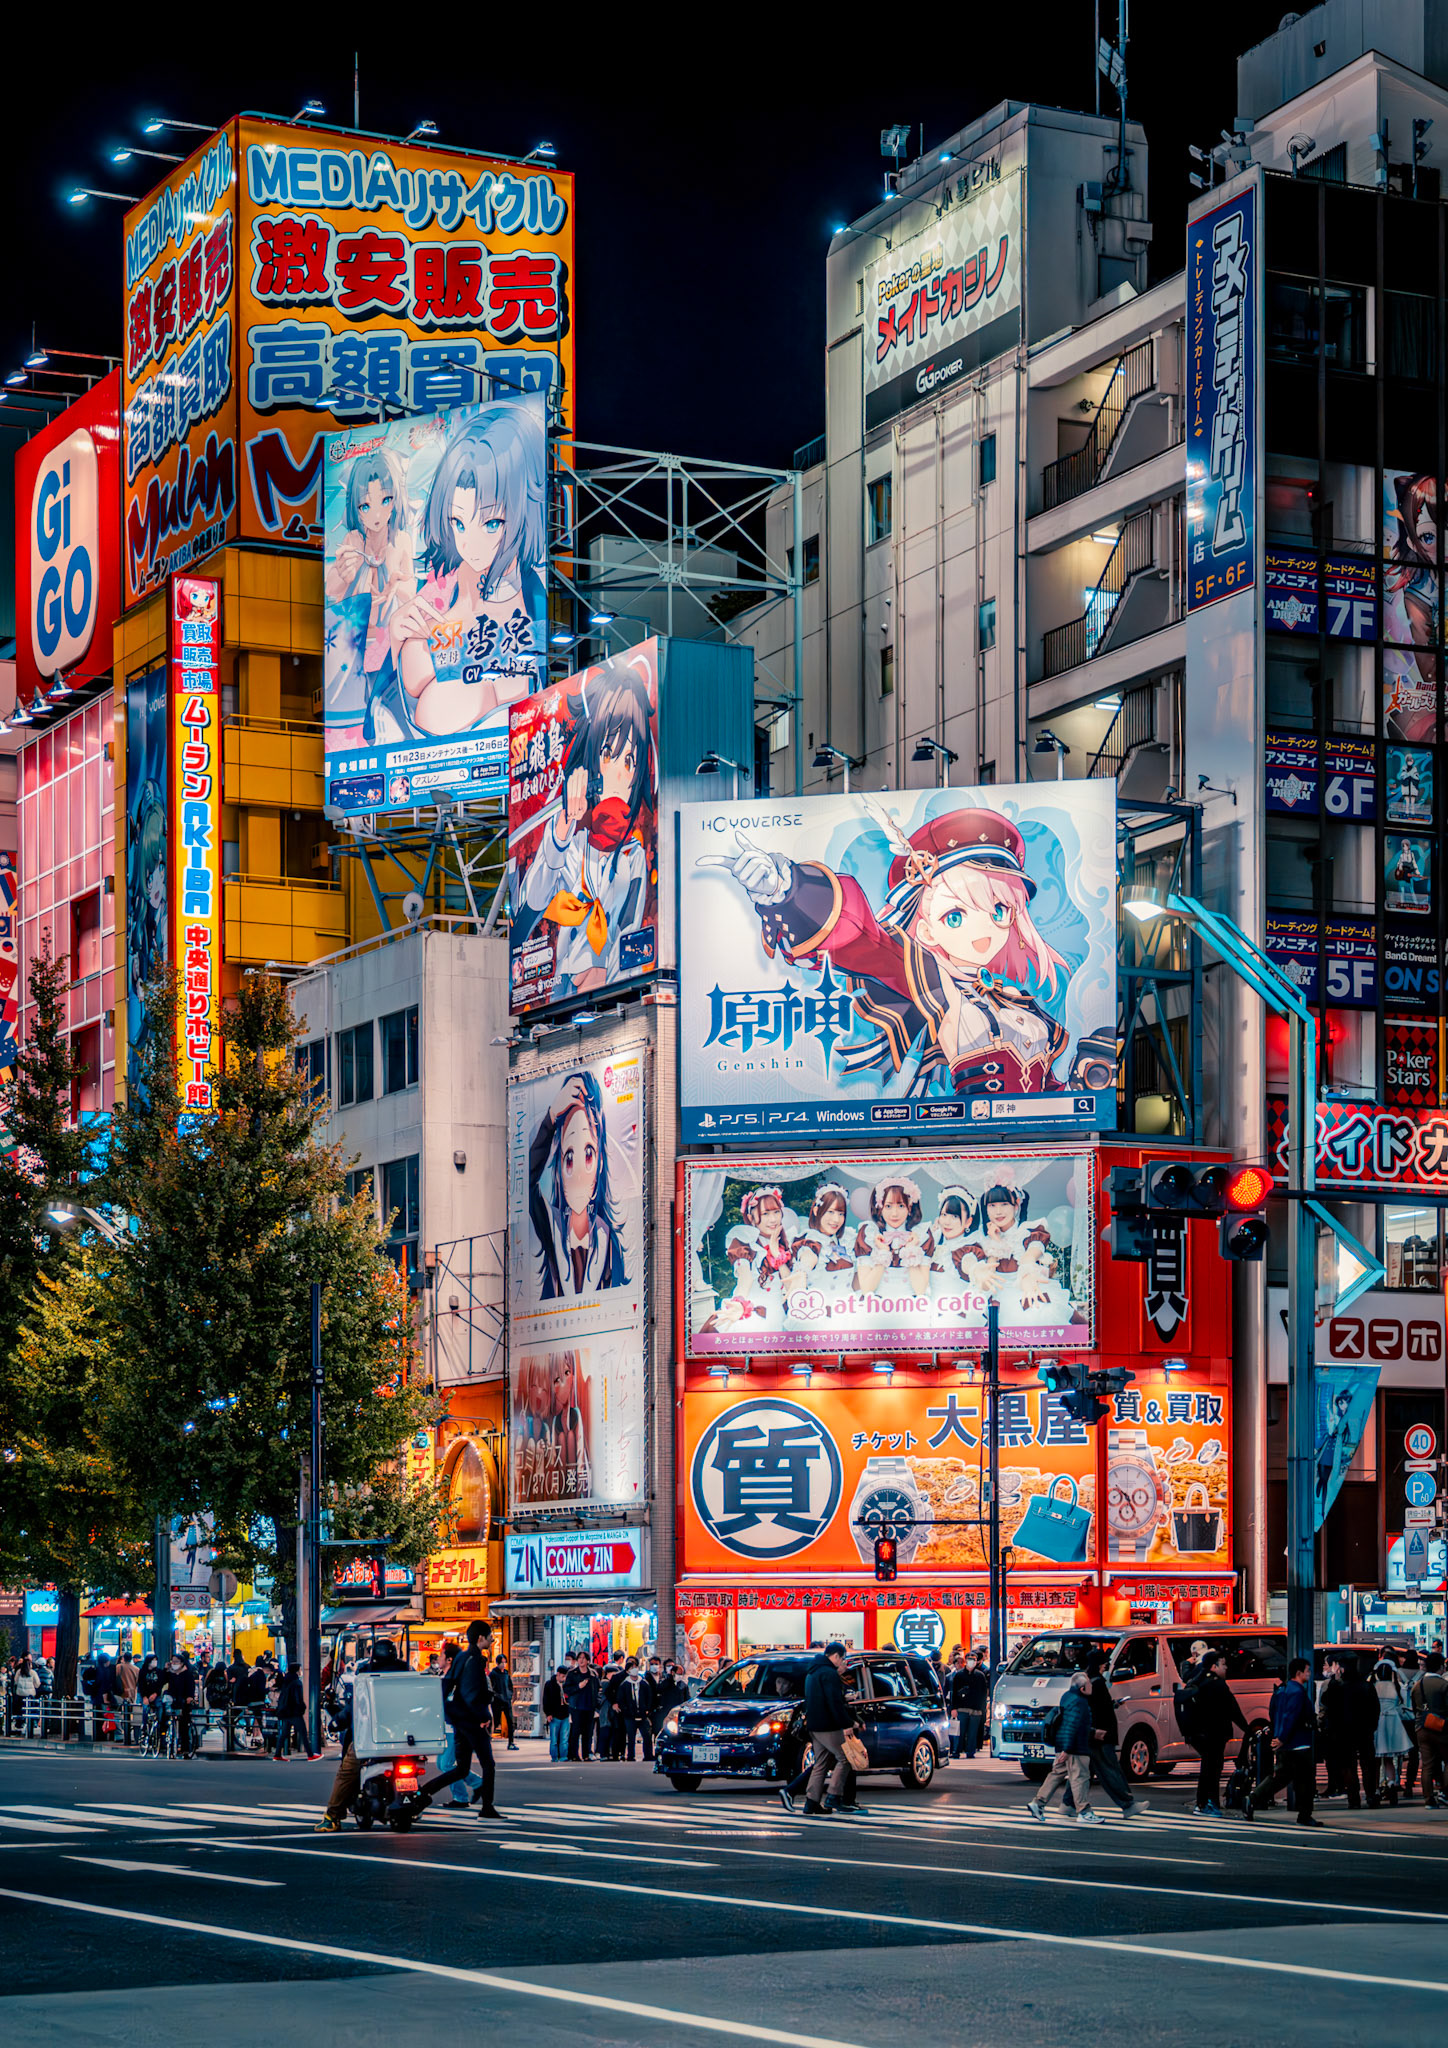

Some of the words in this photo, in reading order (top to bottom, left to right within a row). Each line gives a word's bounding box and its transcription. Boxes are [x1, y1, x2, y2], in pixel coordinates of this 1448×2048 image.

[247, 144, 565, 233] MEDIAリサイクル
[126, 132, 232, 290] MEDIAリサイクル
[250, 212, 562, 336] 激安販売
[878, 242, 943, 305] Pokerの聖地
[127, 208, 232, 380] 激安販売
[877, 235, 1008, 364] メイドカジノ
[247, 319, 558, 416] 高額買取
[127, 430, 236, 594] Mulan
[1266, 555, 1317, 570] トレーディング
[1324, 563, 1370, 578] カードゲーム
[1266, 571, 1317, 590] アメニティ
[1267, 599, 1317, 613] AMENITY
[1272, 610, 1311, 623] DREAM
[1327, 598, 1374, 638] 7F
[182, 623, 212, 643] 買取
[431, 620, 463, 652] SSR
[182, 646, 212, 667] 販売
[182, 671, 213, 692] 市場
[511, 732, 529, 768] SSR
[529, 718, 565, 774] 飛鳥
[1266, 734, 1317, 749] トレーディング
[1325, 741, 1369, 755] カードゲーム
[1266, 750, 1317, 768] アメニティ
[415, 774, 440, 786] アズレン
[1266, 777, 1316, 792] AMENITY
[1272, 787, 1311, 801] DREAM
[1325, 776, 1375, 815] 6F
[702, 813, 803, 842] HOYOVERSE
[1266, 919, 1317, 933] トレーディング
[1325, 925, 1370, 938] カードゲーム
[1266, 936, 1317, 952] アメニティ
[1385, 950, 1408, 961] BanG
[1408, 952, 1437, 964] Dream!
[1326, 959, 1374, 998] 5F
[1384, 966, 1423, 992] ON
[702, 979, 853, 1081] 原神
[717, 1058, 804, 1071] Genshin
[1387, 1067, 1431, 1087] Stars
[719, 1112, 758, 1126] PS5
[768, 1110, 808, 1124] PS4
[816, 1110, 865, 1123] Windows
[995, 1103, 1016, 1114] 原神
[799, 1296, 814, 1308] at
[834, 1293, 928, 1314] at-home
[937, 1291, 985, 1312] cafe
[1335, 1324, 1438, 1356] スマホ
[852, 1432, 918, 1450] チケット
[927, 1393, 1088, 1449] 大黒屋
[1411, 1434, 1429, 1450] 40
[514, 1445, 564, 1471] コミックス
[711, 1423, 821, 1537] 質
[1412, 1481, 1424, 1503] P
[510, 1537, 543, 1588] ZIN
[546, 1546, 591, 1575] COMIC
[593, 1546, 613, 1573] ZIN
[546, 1579, 584, 1588] Akihabara
[1138, 1584, 1230, 1598] 1階にて高価買取中
[678, 1592, 733, 1607] 高価買取
[1020, 1591, 1076, 1606] 無料査定
[900, 1614, 939, 1650] 質
